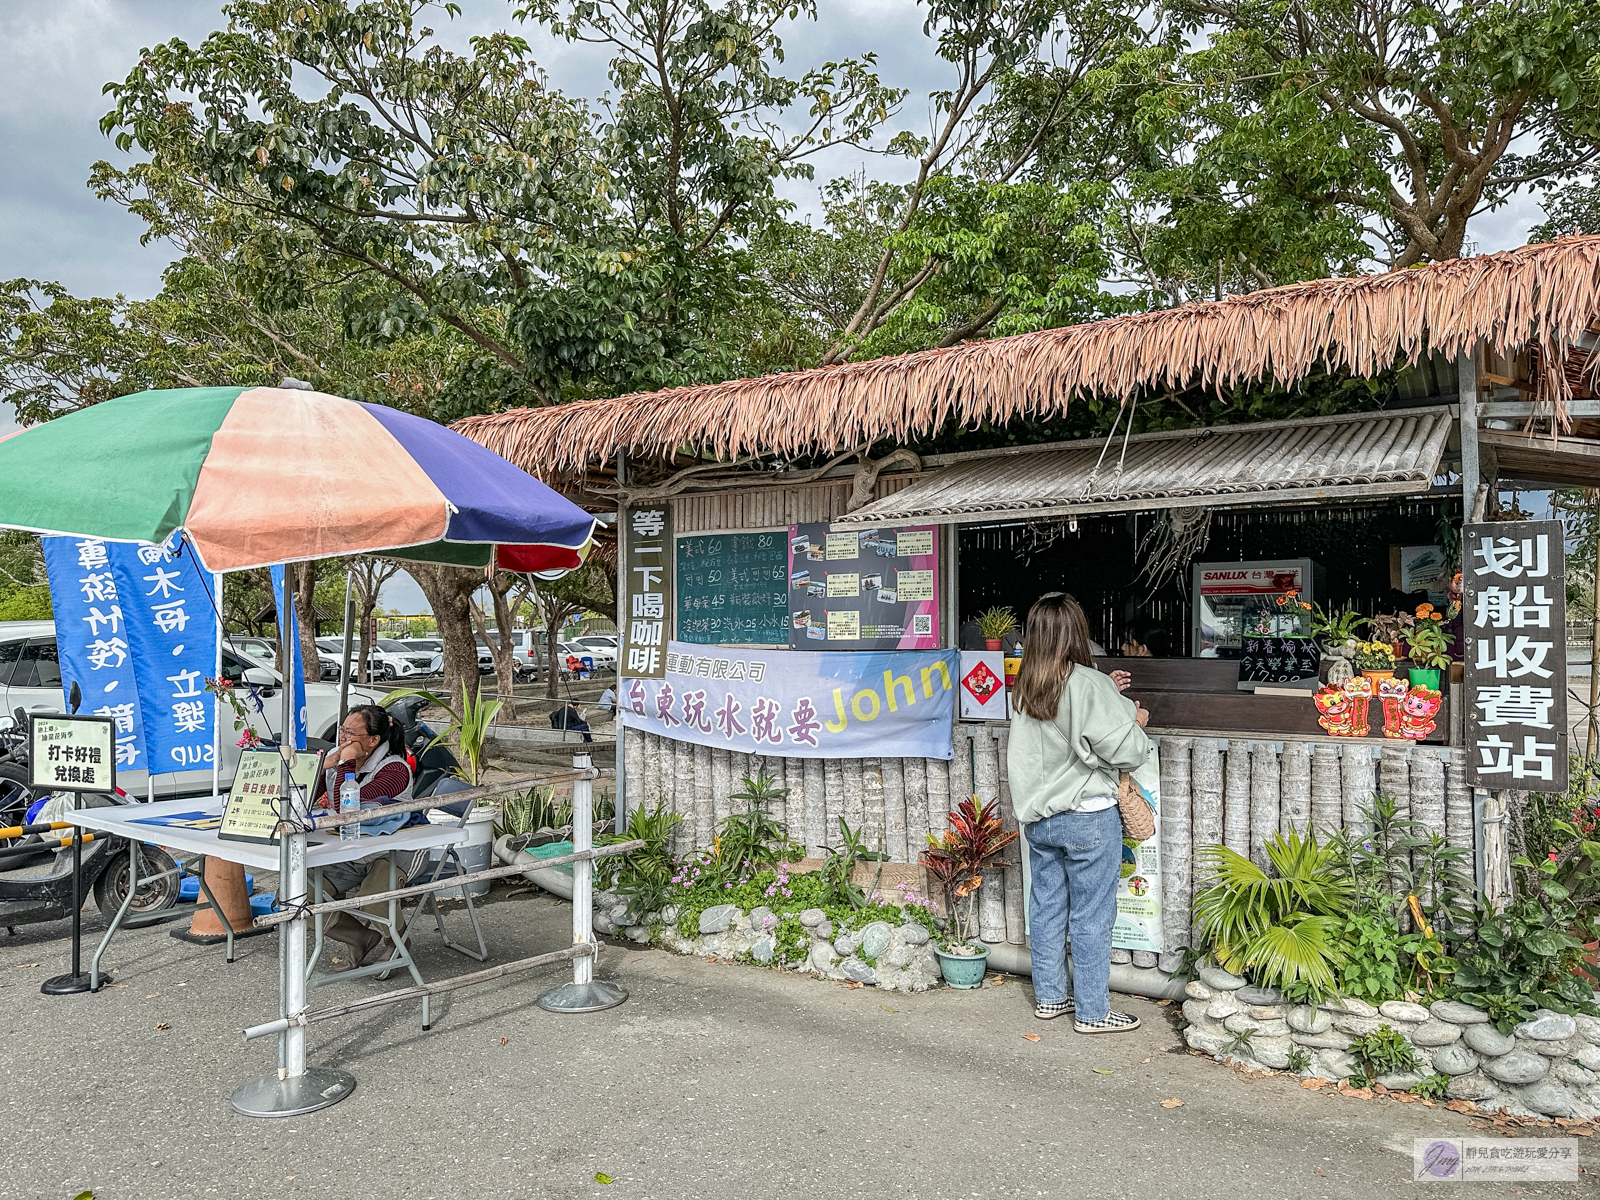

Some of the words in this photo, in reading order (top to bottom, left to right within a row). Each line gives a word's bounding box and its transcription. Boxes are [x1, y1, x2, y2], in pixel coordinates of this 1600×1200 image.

[685, 540, 704, 557] 美式
[708, 538, 722, 554] 60
[757, 534, 773, 548] 80
[684, 573, 704, 587] 可可
[707, 569, 722, 583] 50
[731, 566, 771, 584] 美式可可
[772, 565, 786, 579] 65
[1203, 571, 1249, 580] SANLUX
[627, 509, 665, 674] 等一下喝咖啡
[711, 594, 726, 607] 45
[773, 592, 787, 605] 30
[710, 618, 721, 629] 30
[745, 618, 757, 628] 25
[780, 616, 789, 628] 15
[1246, 640, 1316, 654] 新春愉快
[1241, 656, 1315, 672] 今天營業至
[1473, 534, 1556, 781] 划船收費站
[1248, 670, 1301, 683] 17:00
[824, 660, 952, 734] John
[48, 744, 102, 764] 打卡好禮
[54, 765, 95, 784] 兌換處
